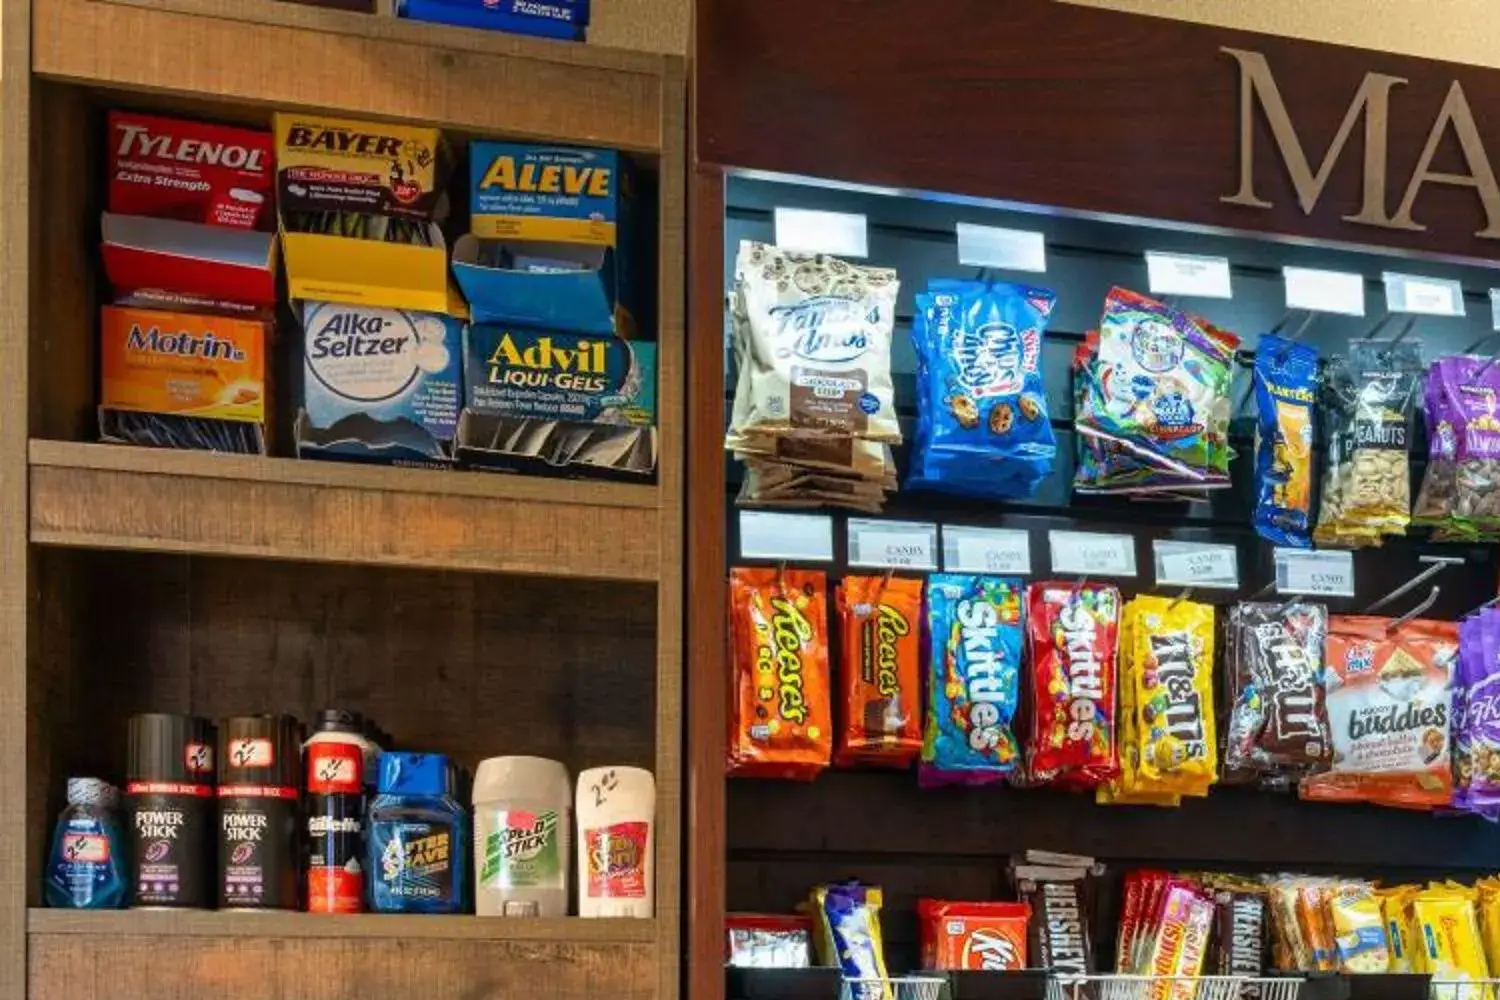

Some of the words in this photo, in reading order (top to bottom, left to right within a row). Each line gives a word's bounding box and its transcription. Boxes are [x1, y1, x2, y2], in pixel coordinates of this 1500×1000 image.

[116, 123, 265, 171] TYLENOL
[285, 124, 401, 157] BAYER
[116, 171, 151, 185] Extra
[154, 175, 212, 192] Strength
[479, 155, 611, 197] ALEVE
[316, 313, 393, 337] Alka-
[127, 323, 233, 359] Motrin
[311, 335, 410, 359] Seltzer
[487, 332, 606, 374] Advil
[876, 602, 910, 698] Reese's
[1348, 700, 1447, 741] buddies
[135, 811, 184, 827] POWER
[223, 814, 267, 829] POWER
[140, 825, 177, 839] STICK
[227, 827, 262, 841] STICK
[506, 834, 546, 858] STICK
